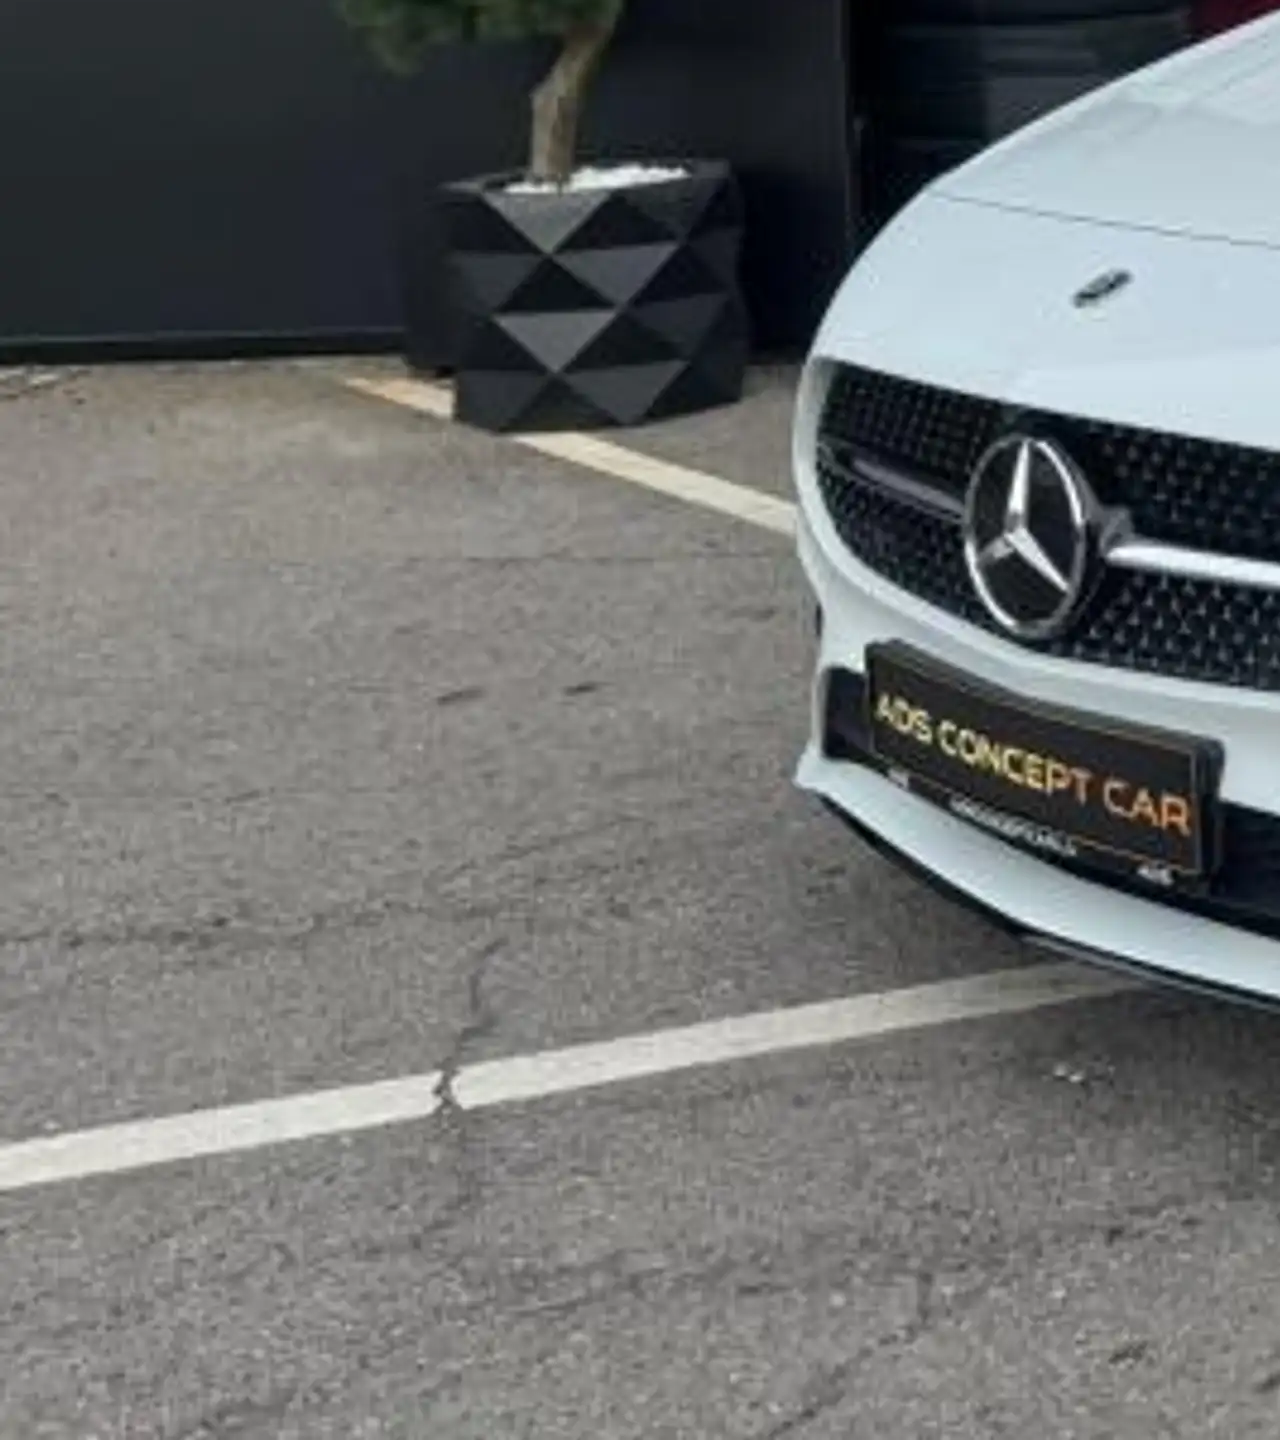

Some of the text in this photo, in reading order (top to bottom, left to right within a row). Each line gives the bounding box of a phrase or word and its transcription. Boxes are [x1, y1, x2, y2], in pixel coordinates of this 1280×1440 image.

[874, 694, 933, 743] ADS
[938, 719, 1092, 805] CONCEPT
[1103, 781, 1191, 836] CAR
